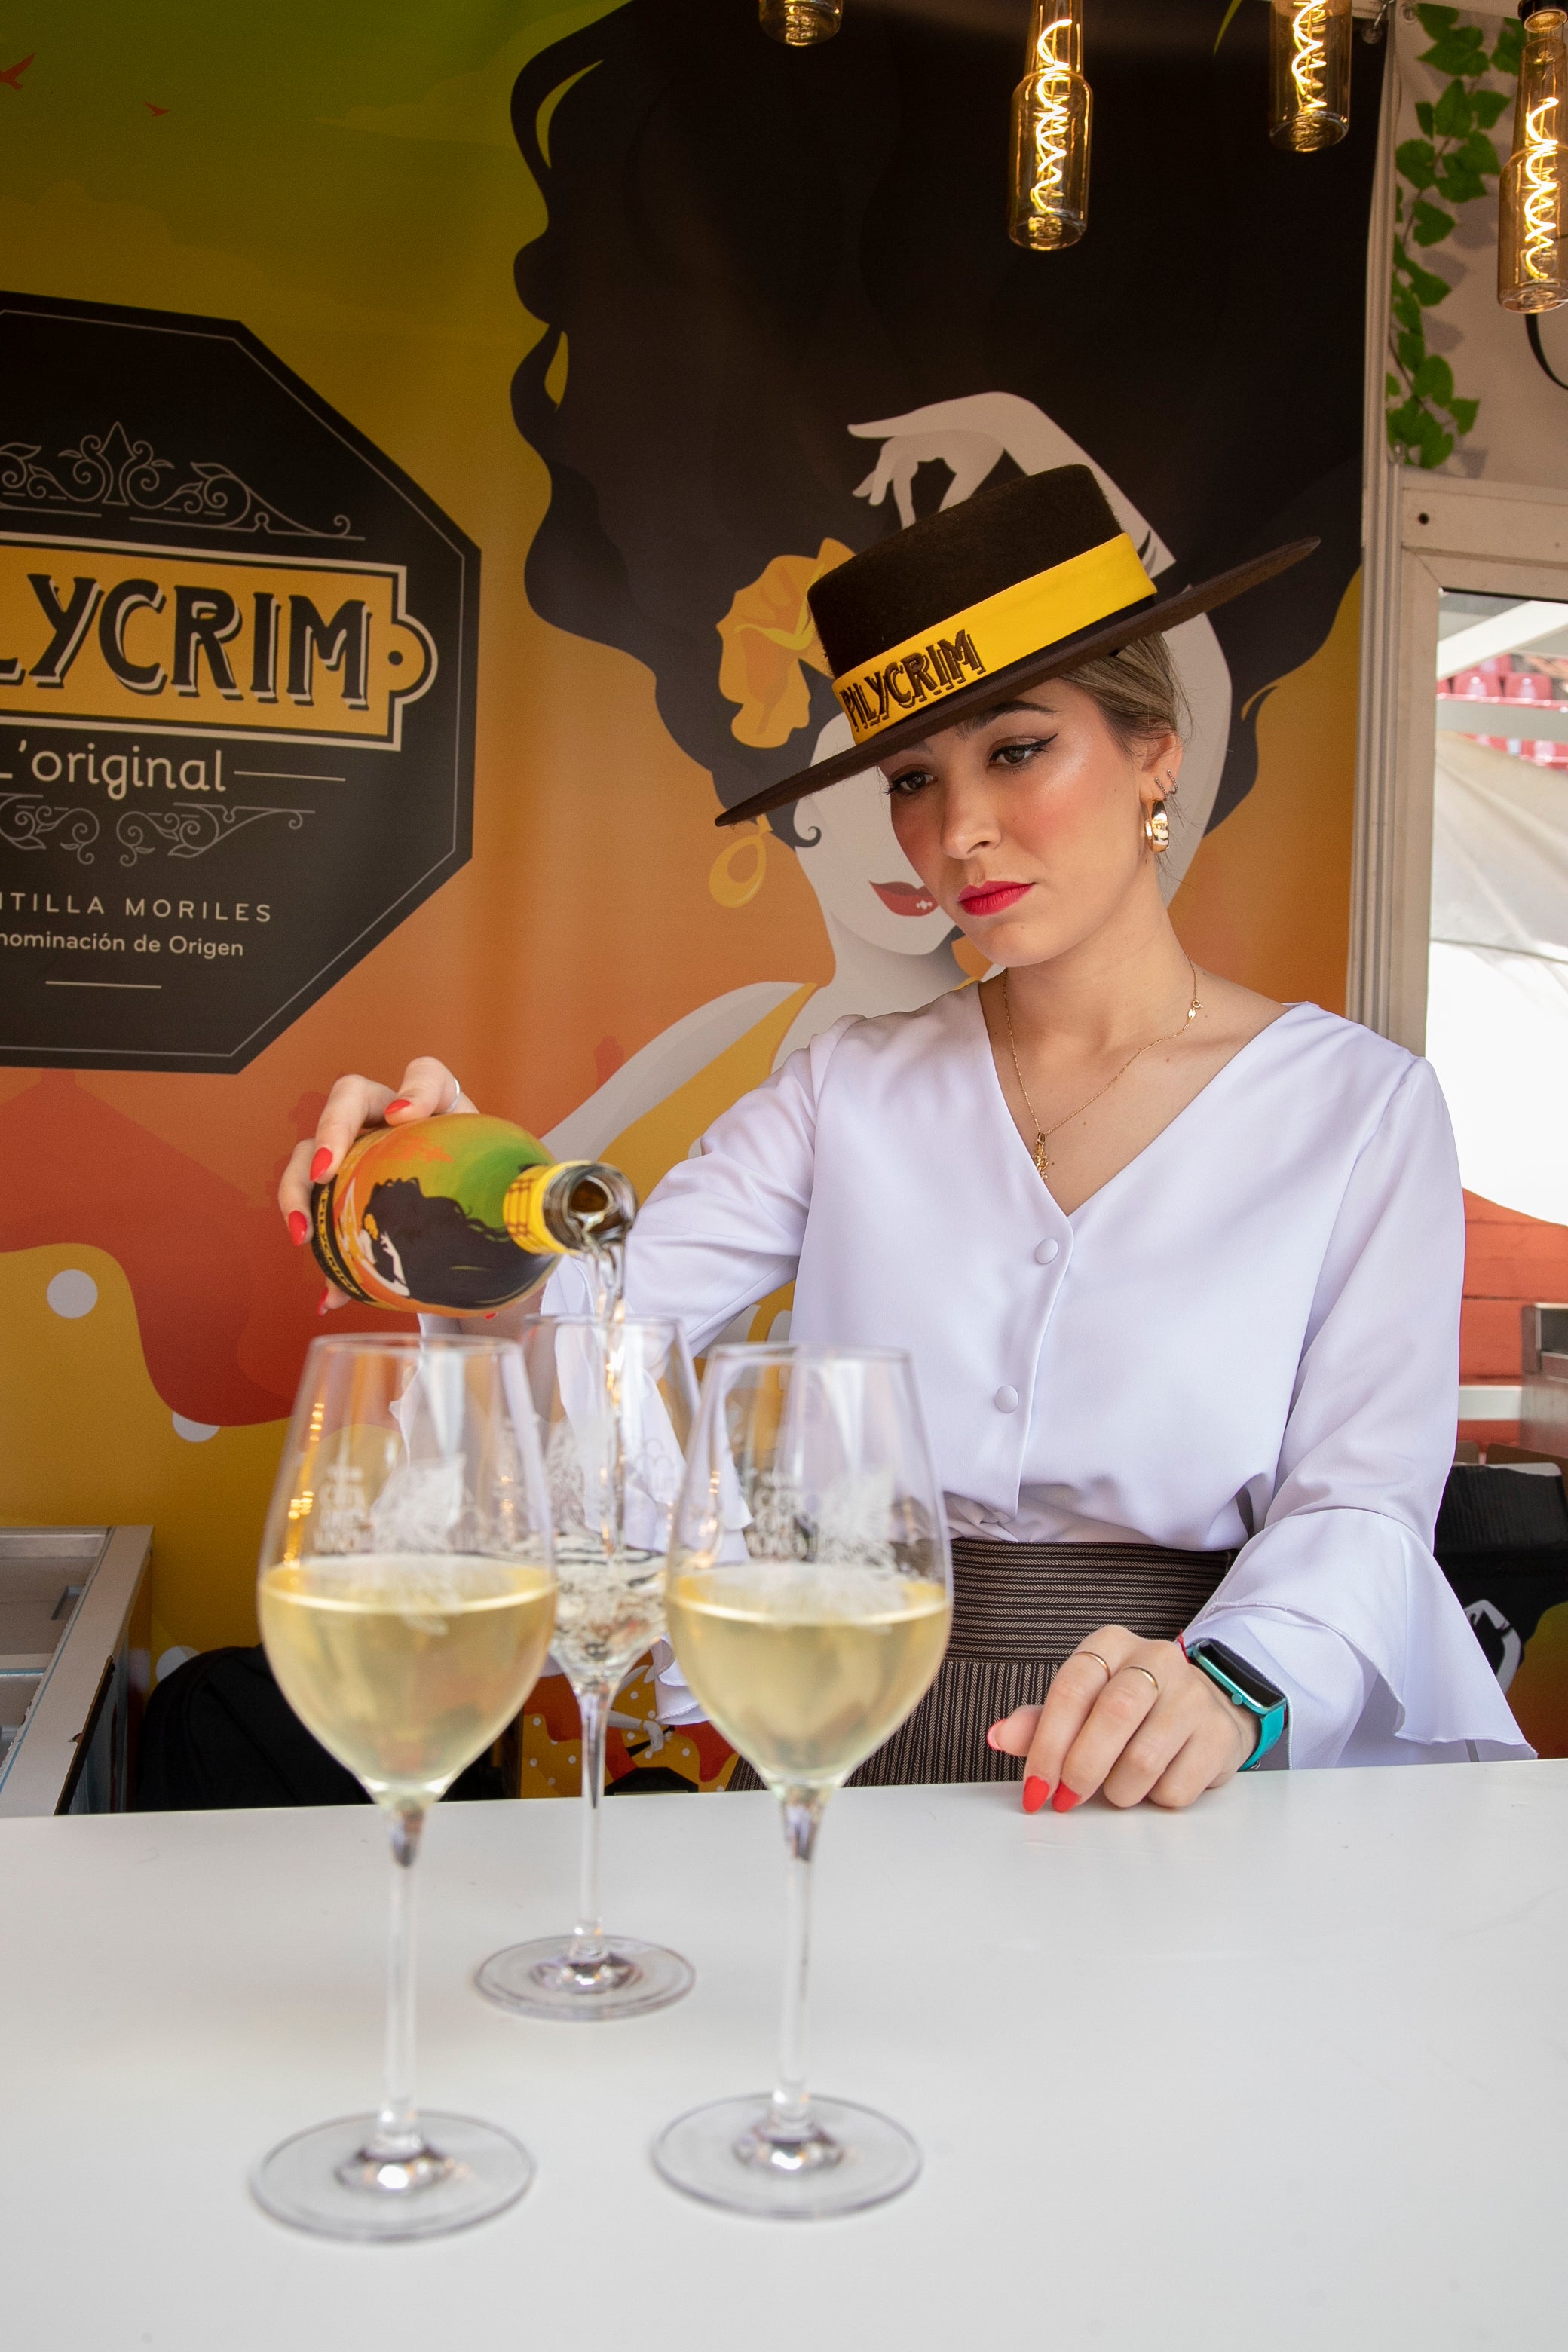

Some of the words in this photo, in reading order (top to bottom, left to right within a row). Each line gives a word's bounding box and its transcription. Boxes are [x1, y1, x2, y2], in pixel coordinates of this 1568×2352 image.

[839, 629, 986, 733] PILYCRIM
[0, 892, 105, 914] TILLA
[125, 898, 271, 923] MORILES
[133, 934, 161, 953] de
[169, 935, 243, 960] Origen
